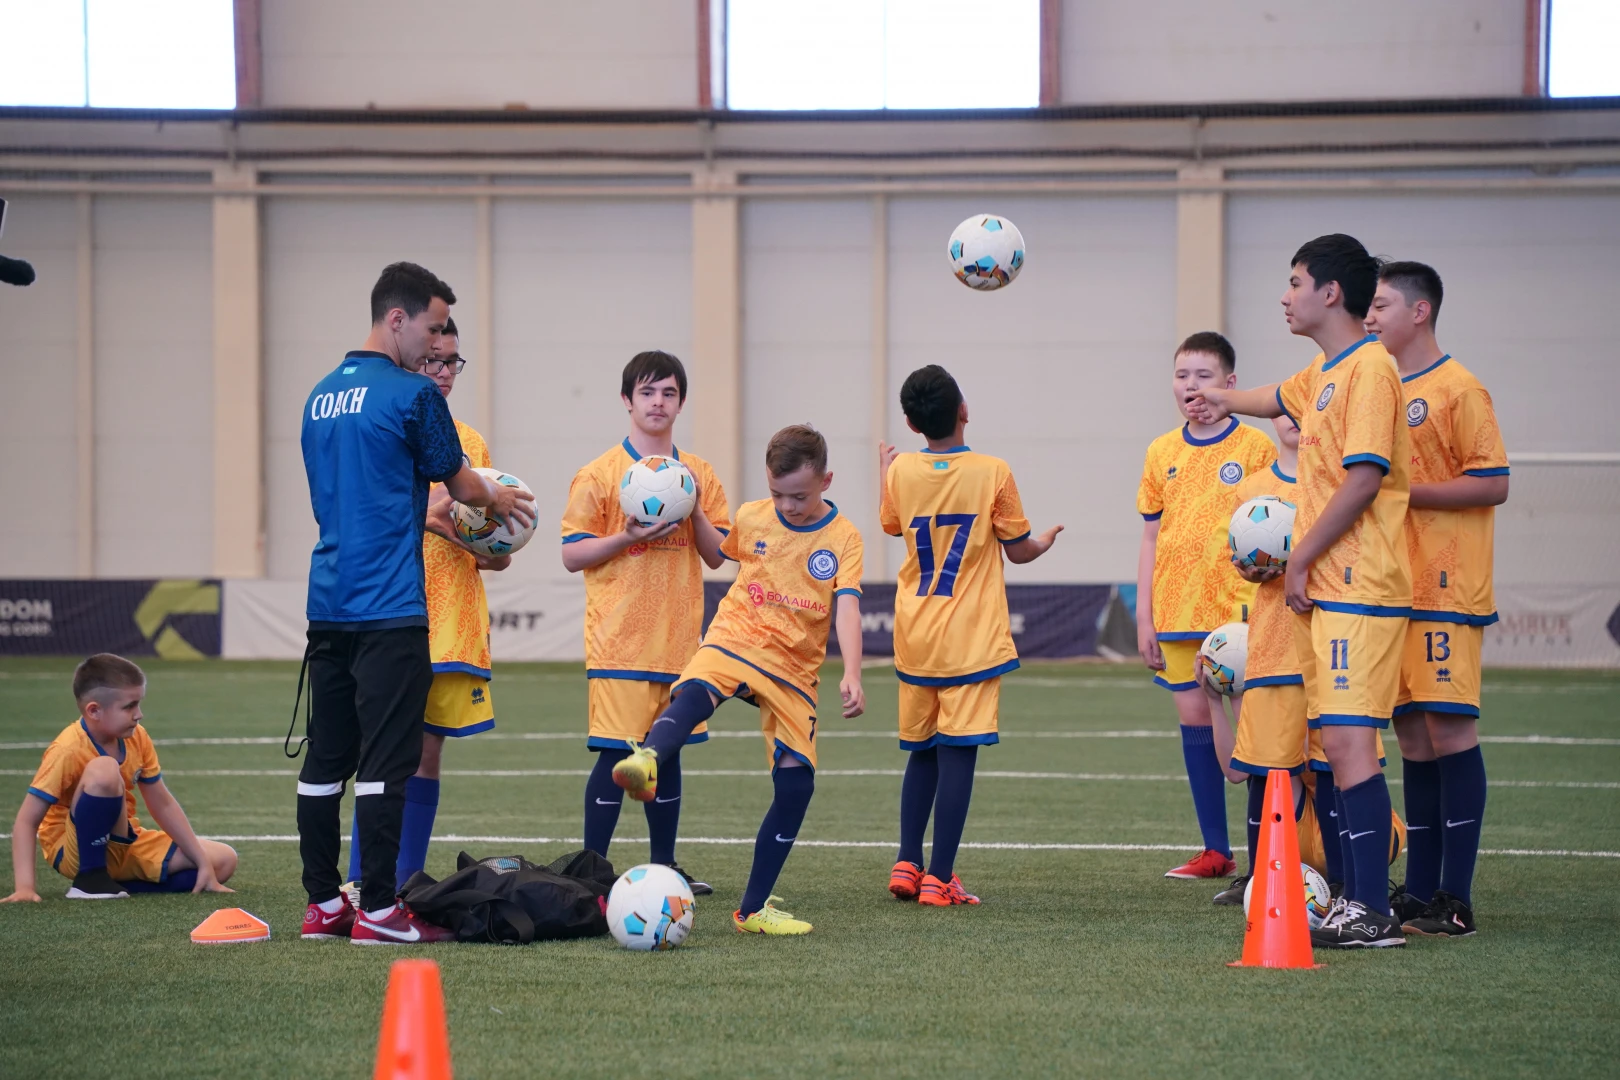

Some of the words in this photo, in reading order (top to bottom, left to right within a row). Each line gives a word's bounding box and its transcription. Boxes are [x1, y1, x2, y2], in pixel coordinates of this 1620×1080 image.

[312, 387, 368, 420] COACH
[909, 513, 979, 597] 17
[766, 591, 827, 614] БОЛАШАК
[490, 610, 544, 631] RT
[1330, 639, 1349, 670] 11
[1424, 632, 1451, 662] 13
[225, 923, 252, 931] TORRES
